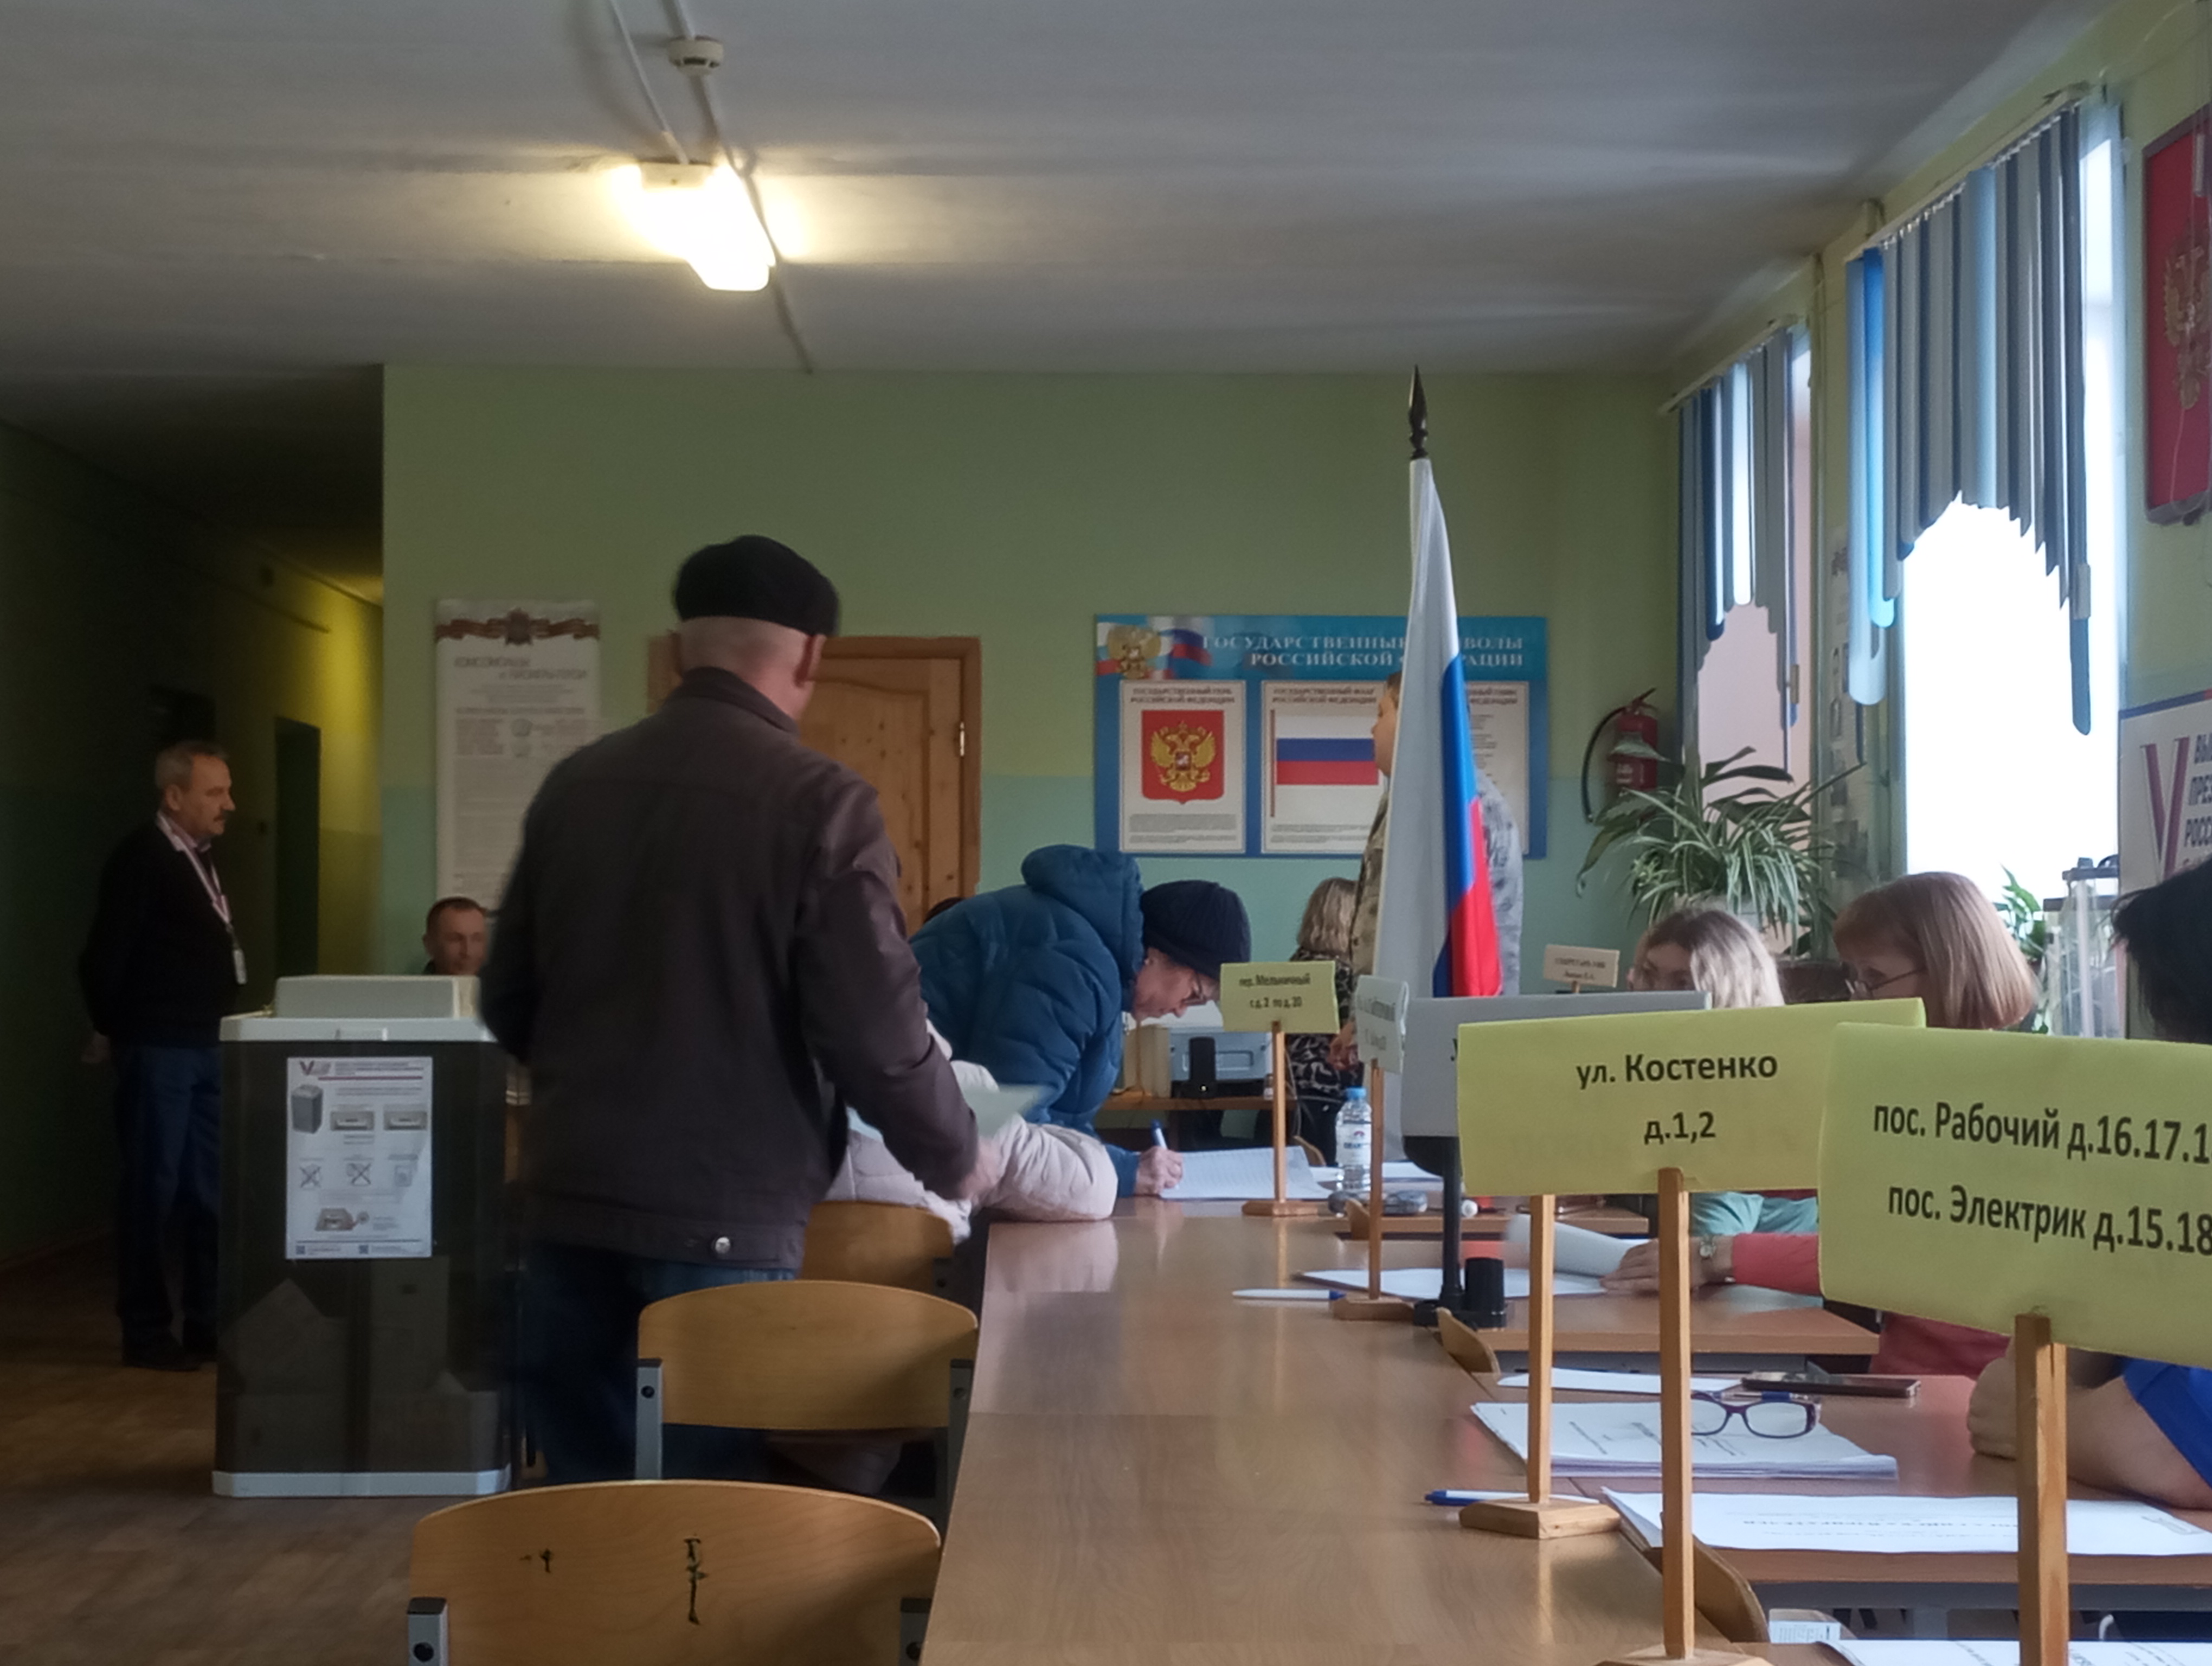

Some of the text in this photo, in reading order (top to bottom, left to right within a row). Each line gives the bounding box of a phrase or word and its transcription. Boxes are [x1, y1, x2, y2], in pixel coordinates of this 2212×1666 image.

[1250, 650, 1393, 666] РОССИЙСКОЙ
[1464, 637, 1523, 650] ВОЛЫ
[1576, 1053, 1778, 1090] ул. Костенко
[1644, 1111, 1716, 1145] д.1,2
[1874, 1101, 2212, 1164] пос. Рабочий д.16.17.1
[1889, 1186, 1941, 1220] пос.
[1950, 1184, 2087, 1243] Электрик
